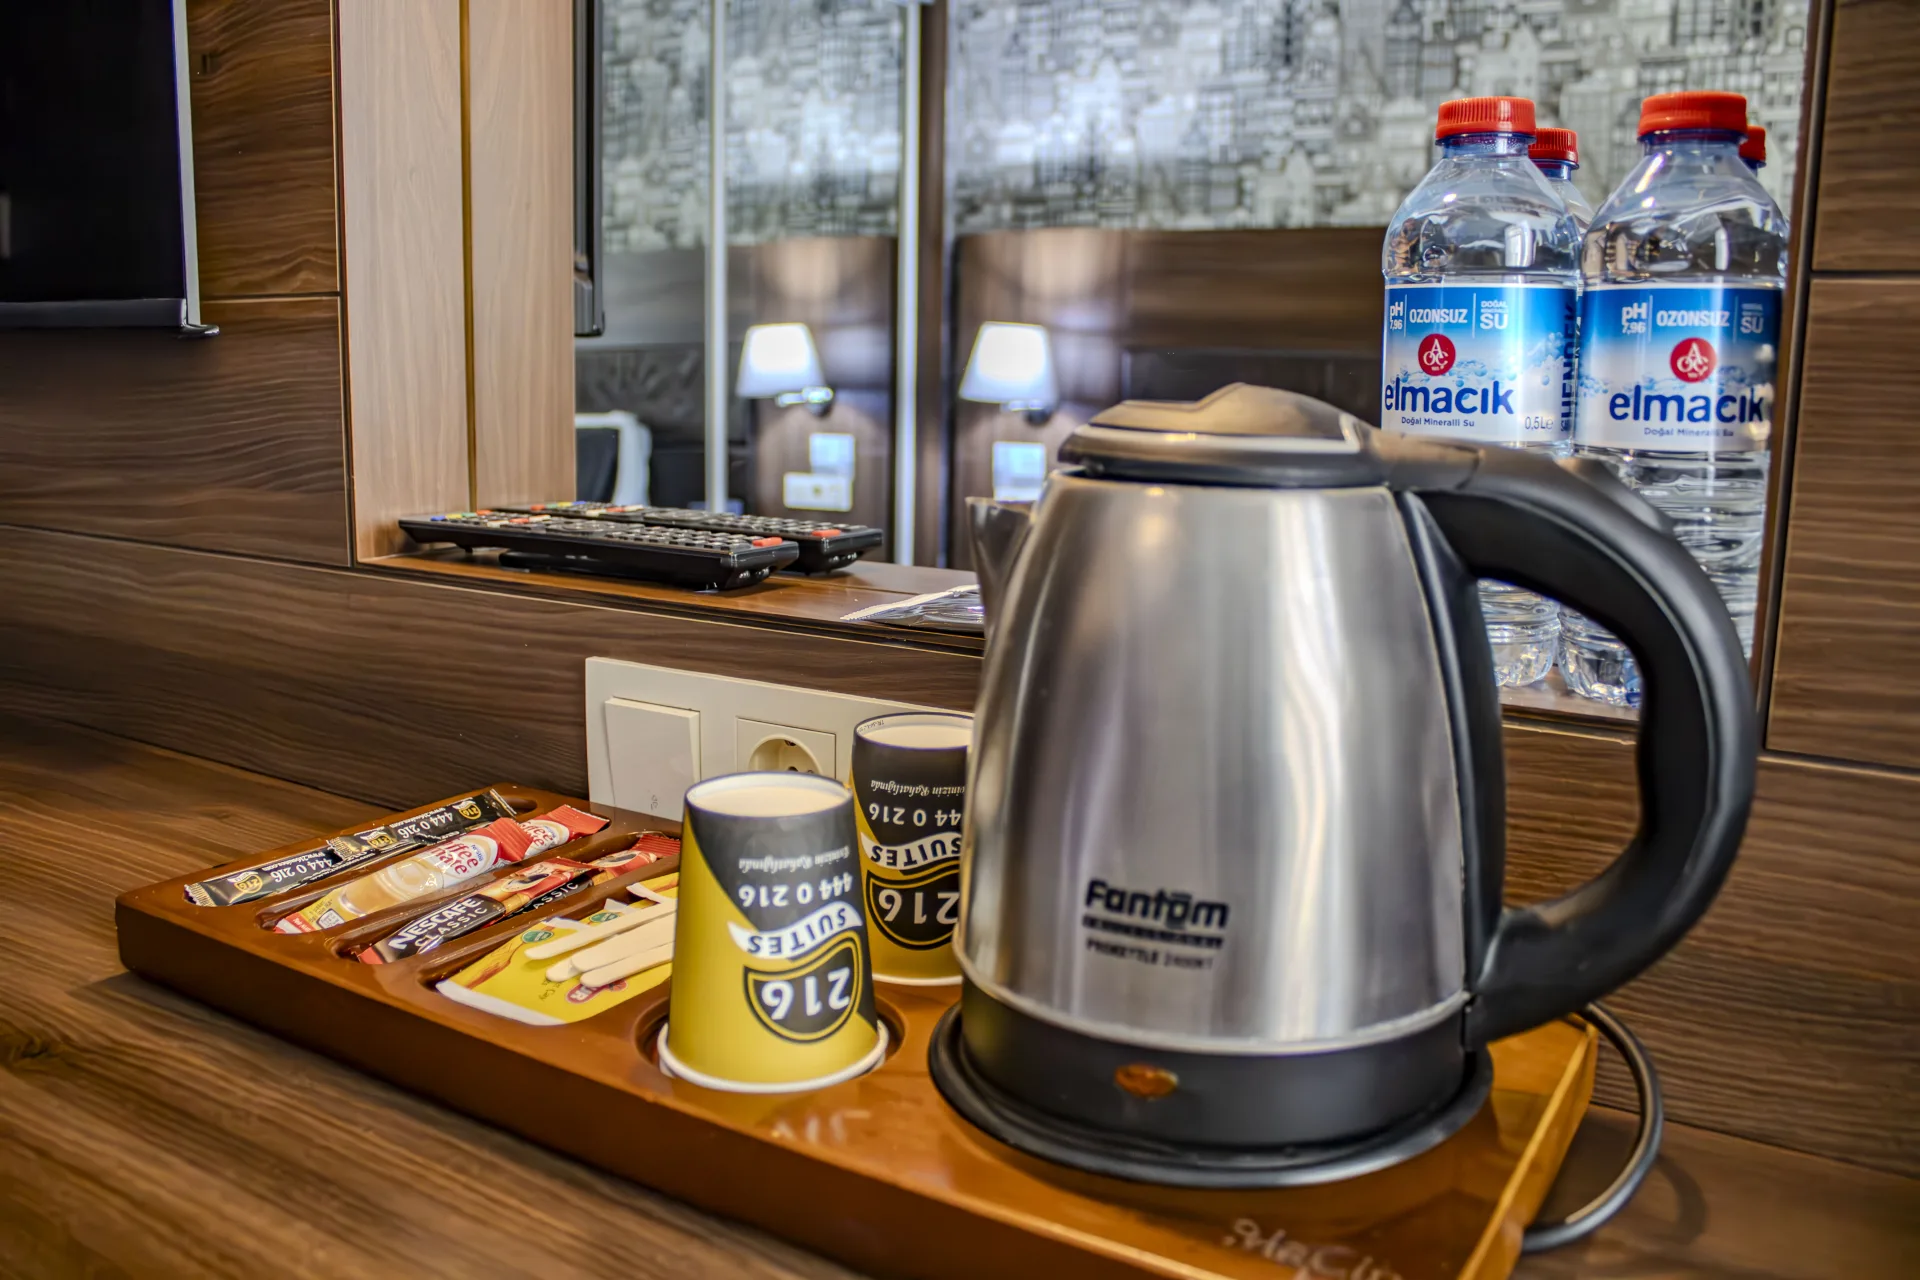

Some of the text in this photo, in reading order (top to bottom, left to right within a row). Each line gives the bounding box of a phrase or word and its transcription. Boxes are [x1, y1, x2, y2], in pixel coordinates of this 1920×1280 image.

[1389, 301, 1404, 319] pH
[1409, 308, 1469, 324] OZONSUZ
[1621, 302, 1648, 324] pH
[1656, 310, 1730, 327] OZONSUZ
[1480, 312, 1509, 330] SU
[1740, 316, 1764, 334] SU
[1385, 376, 1514, 415] elmacık
[1609, 384, 1764, 423] elmacık
[1401, 416, 1422, 427] Doğal
[1463, 418, 1475, 427] Su
[932, 784, 965, 797] vinizin
[429, 811, 453, 827] 444
[868, 802, 962, 827] 44 0 216
[397, 824, 421, 839] 216
[419, 820, 431, 830] 0
[869, 835, 962, 867] SUITES
[295, 864, 307, 874] 0
[307, 857, 333, 871] 444
[270, 867, 296, 883] 216
[532, 882, 579, 910] ASSIC
[738, 871, 854, 908] 444 0 216
[878, 889, 960, 925] 216
[414, 907, 488, 947] CLASSIC
[746, 906, 847, 955] SUITES
[760, 966, 853, 1021] 216
